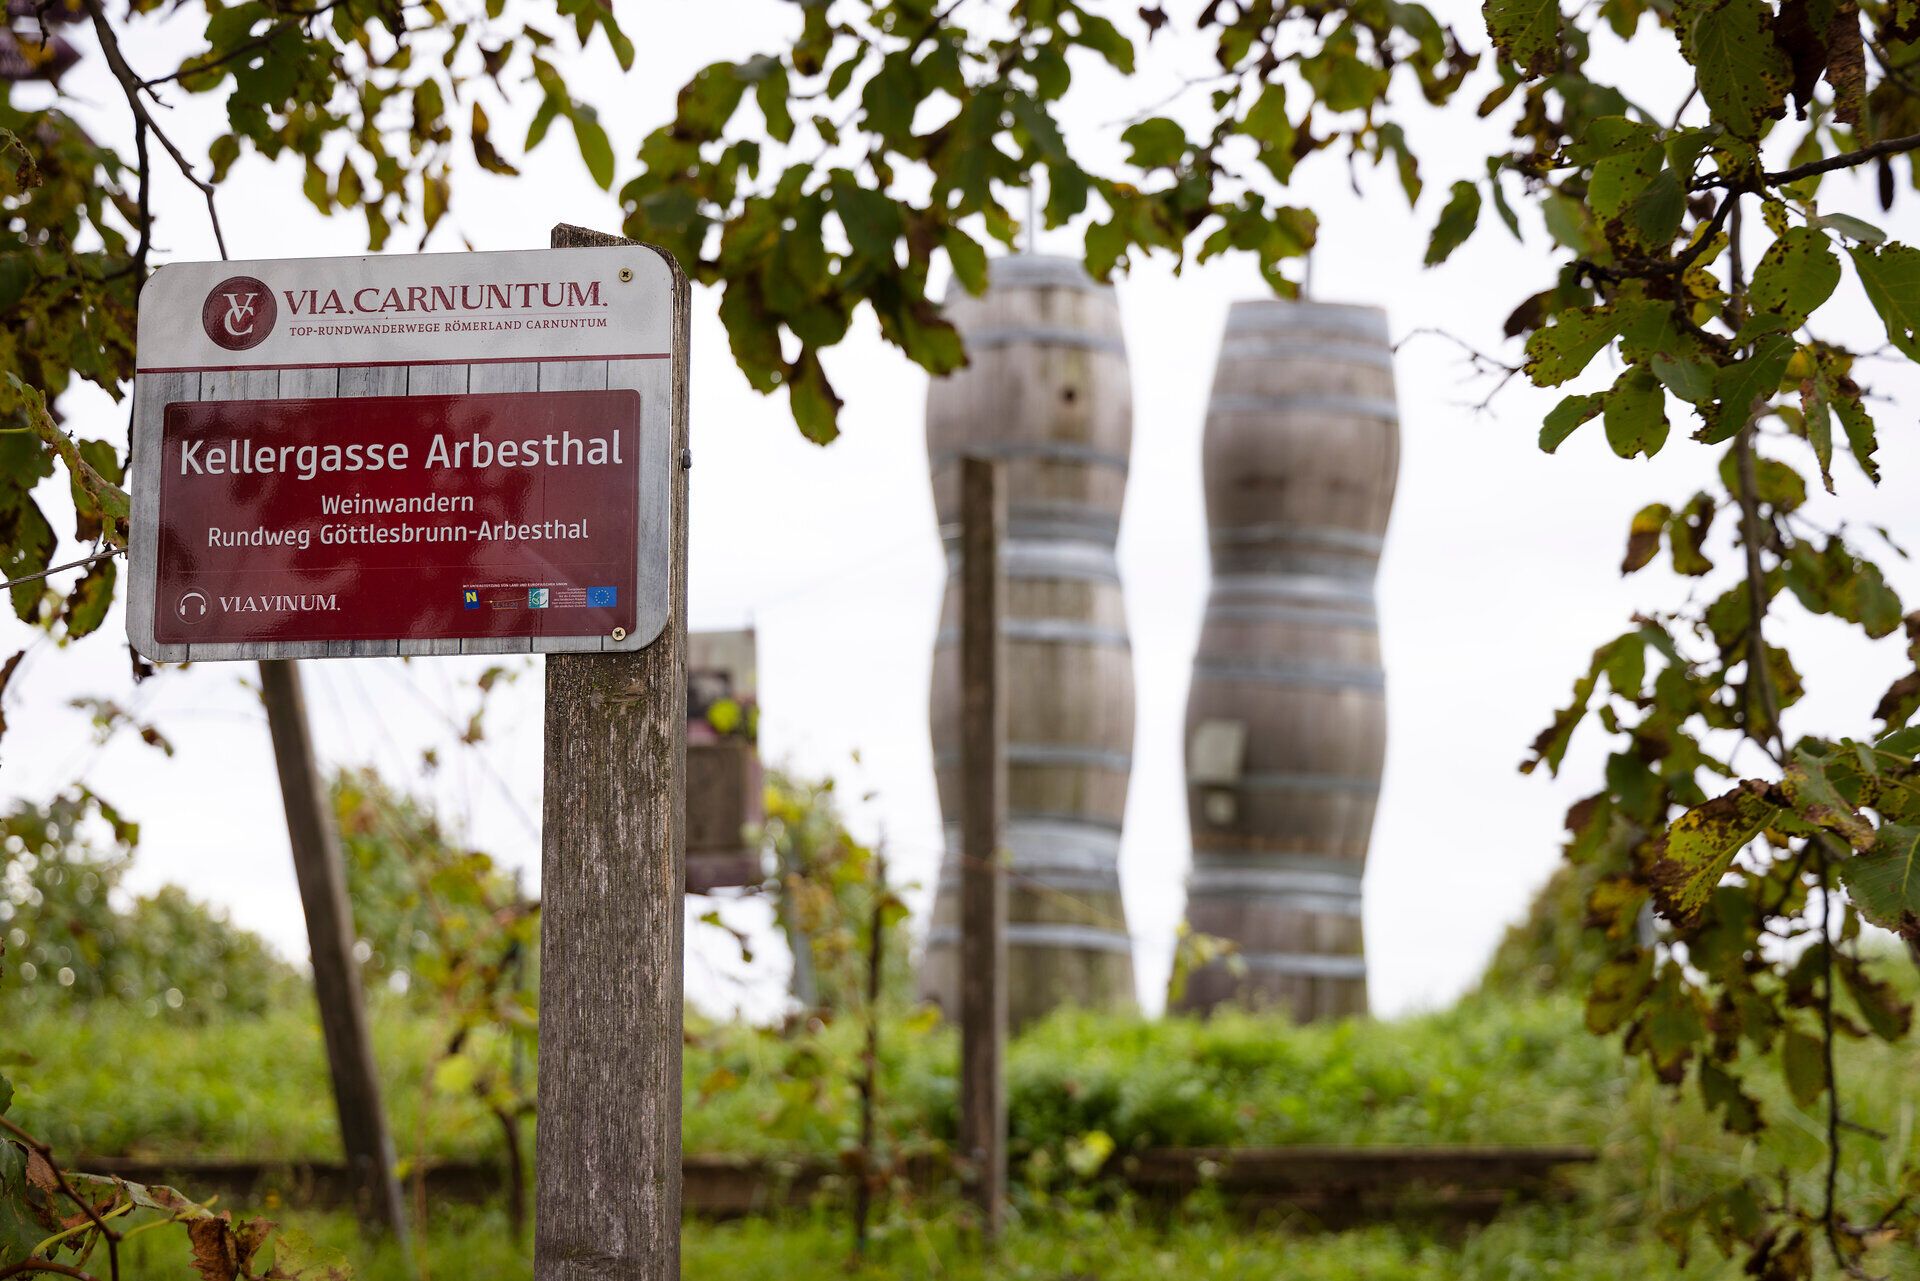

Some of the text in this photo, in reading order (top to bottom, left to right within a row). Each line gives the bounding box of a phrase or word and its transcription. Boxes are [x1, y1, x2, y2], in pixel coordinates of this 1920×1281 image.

[289, 318, 608, 337] TOP-RUNDWANDERWEGE RÖMERLAND CARNUNTUM
[180, 429, 623, 481] Kellergasse Arbesthal
[321, 492, 475, 515] Weinwandern
[207, 518, 589, 550] Rundweg Göttlesbrunn-Arbesthal
